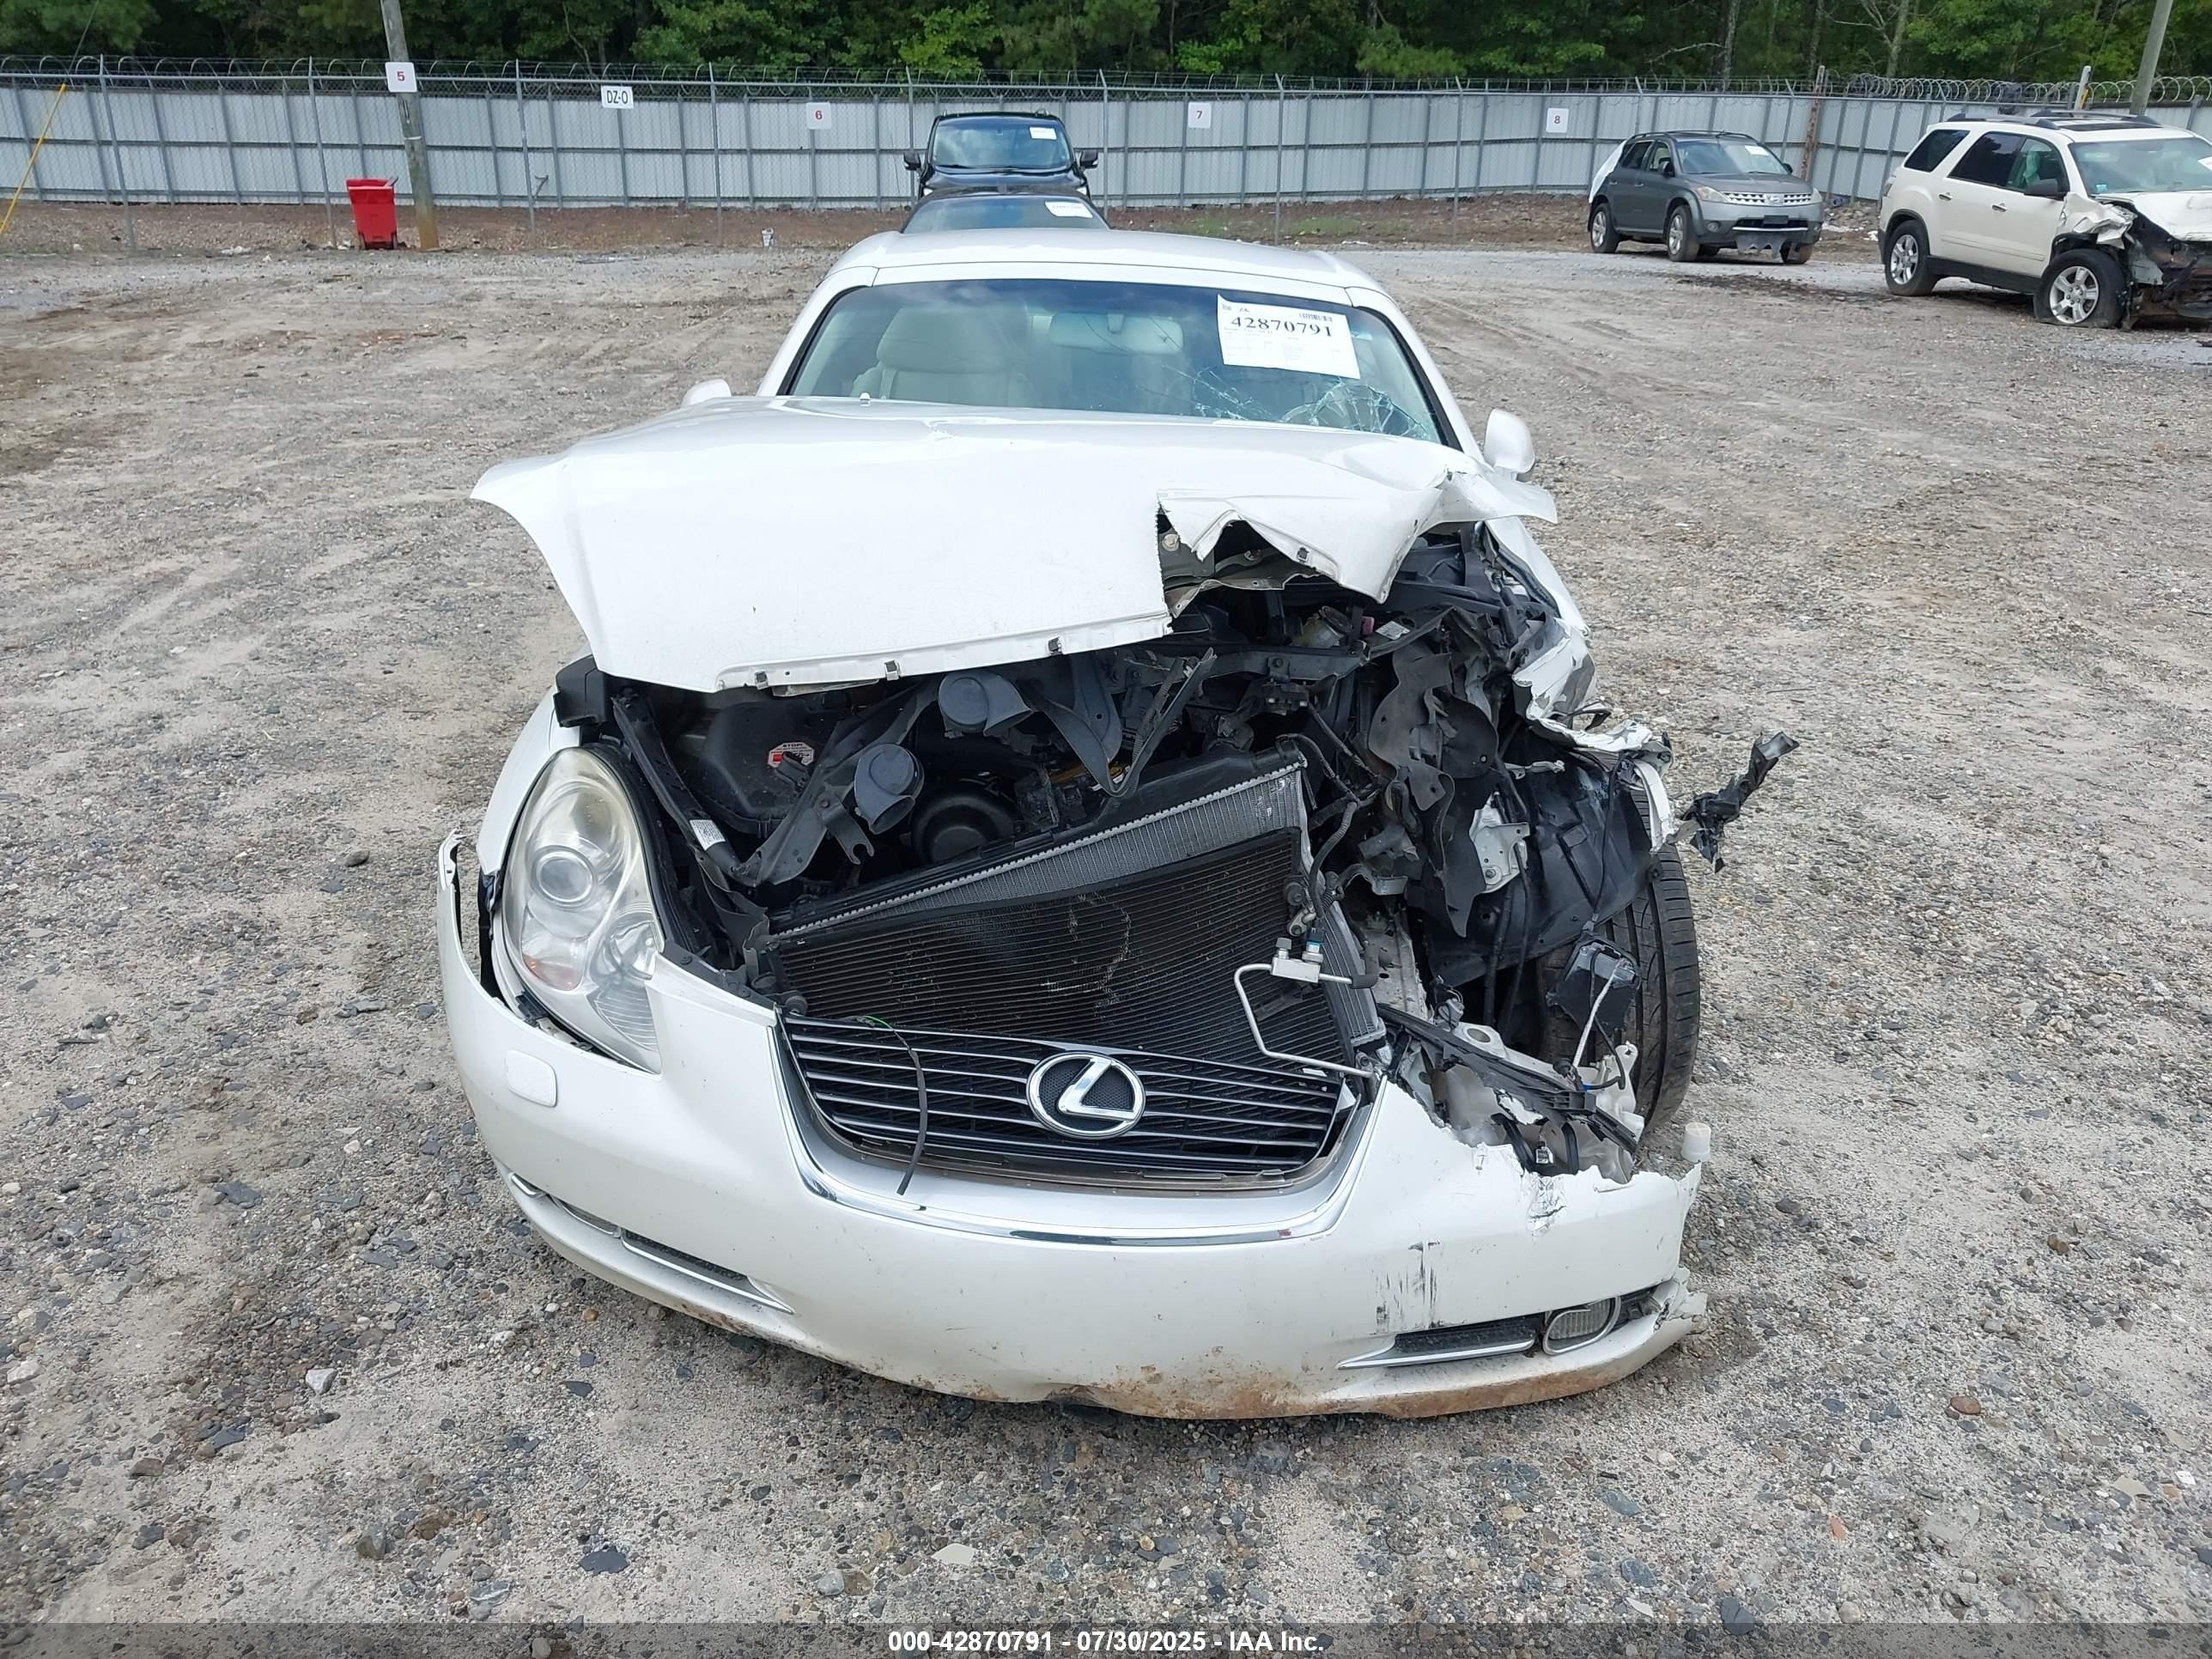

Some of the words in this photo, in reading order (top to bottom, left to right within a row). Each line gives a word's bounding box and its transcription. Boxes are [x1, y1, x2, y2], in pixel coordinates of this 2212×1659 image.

[397, 70, 405, 82] 5
[815, 110, 823, 120] 6
[1195, 110, 1203, 119] 7
[1553, 115, 1561, 125] 8
[1231, 316, 1332, 337] 42870791
